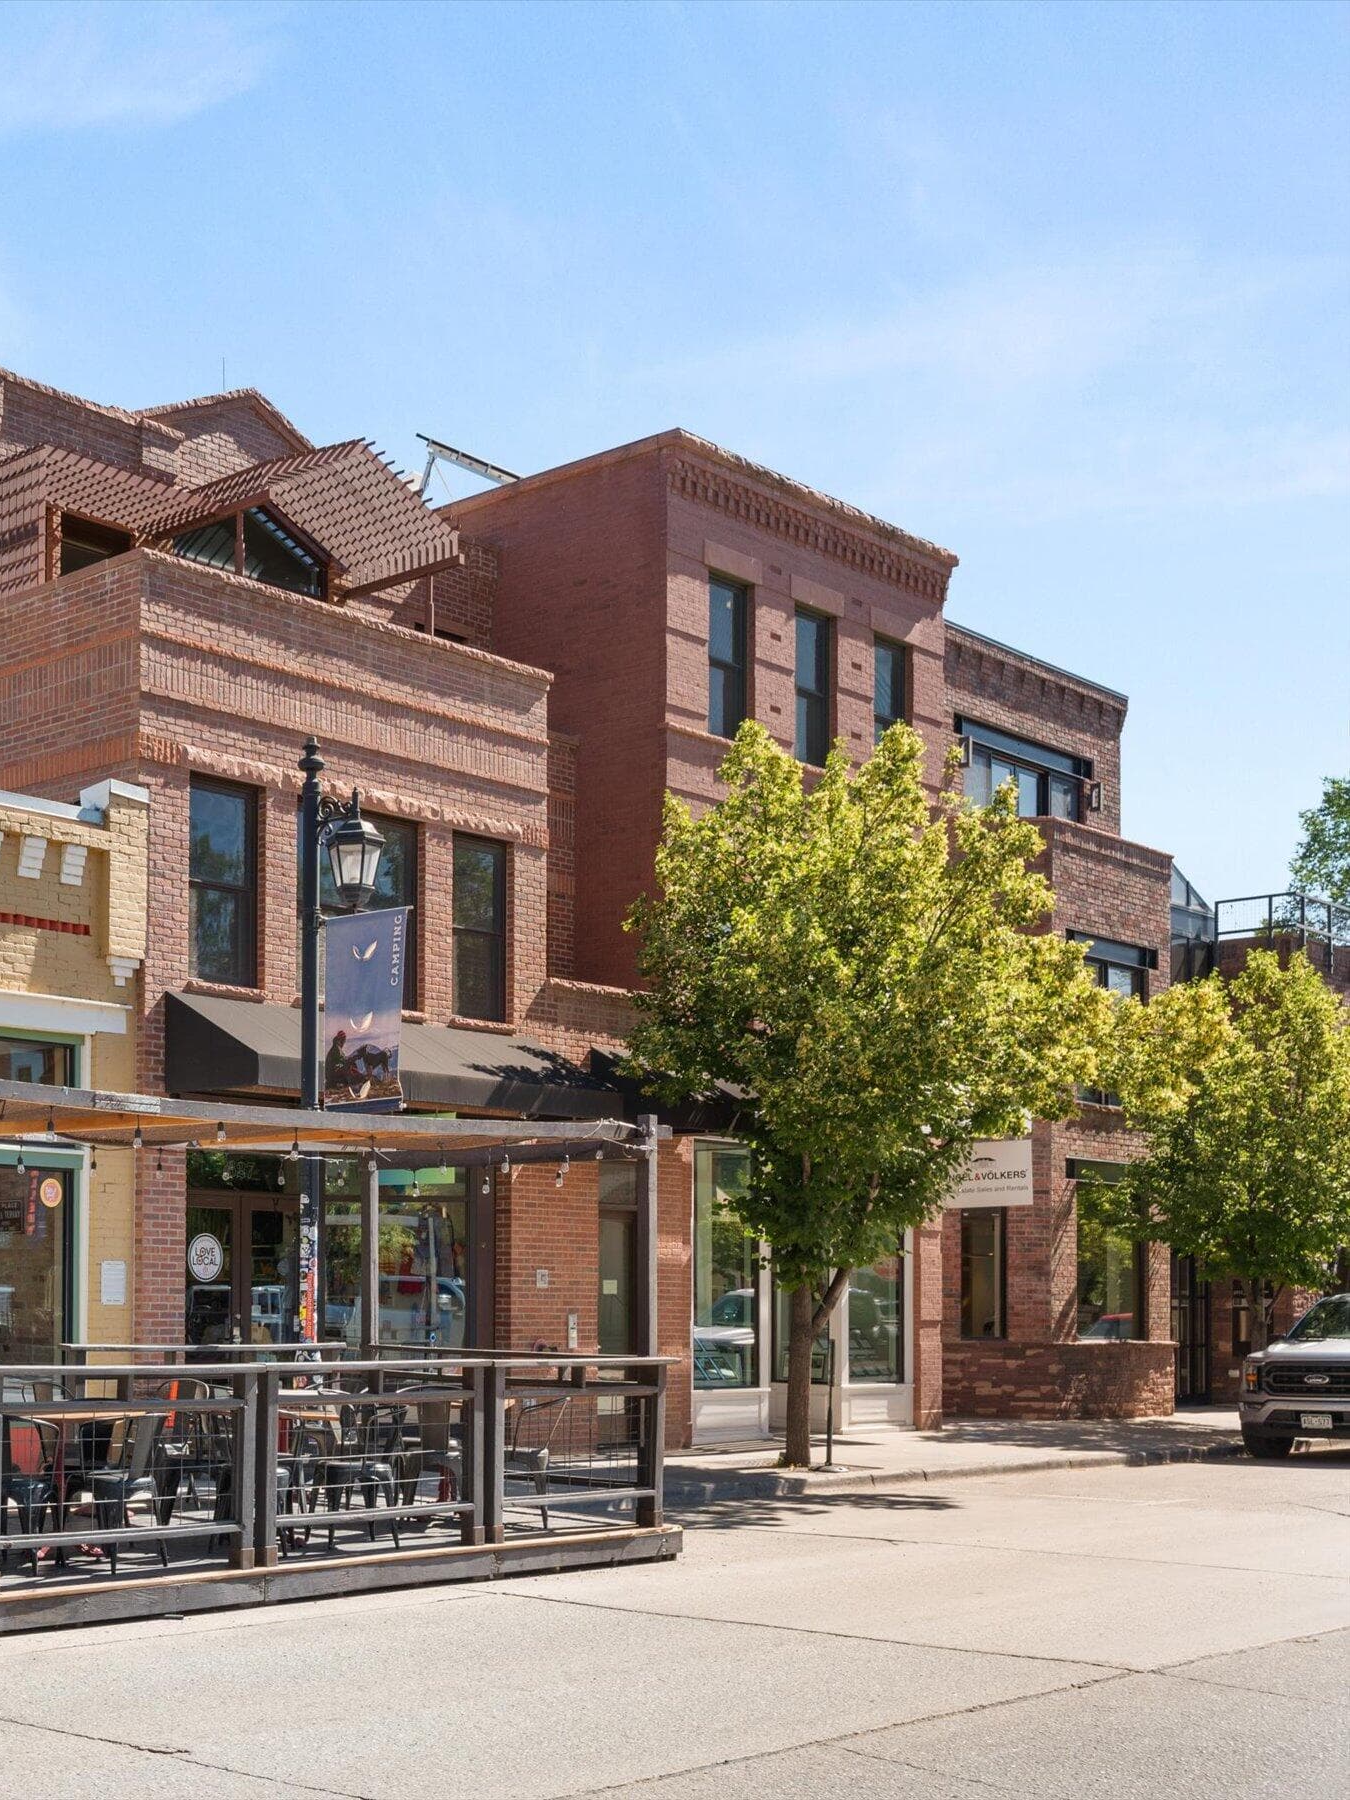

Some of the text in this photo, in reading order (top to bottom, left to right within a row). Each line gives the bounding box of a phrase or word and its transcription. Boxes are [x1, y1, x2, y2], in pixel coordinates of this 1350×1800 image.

[390, 914, 402, 986] CAMPING
[195, 1247, 216, 1257] LOVE
[193, 1256, 219, 1266] LOCAL
